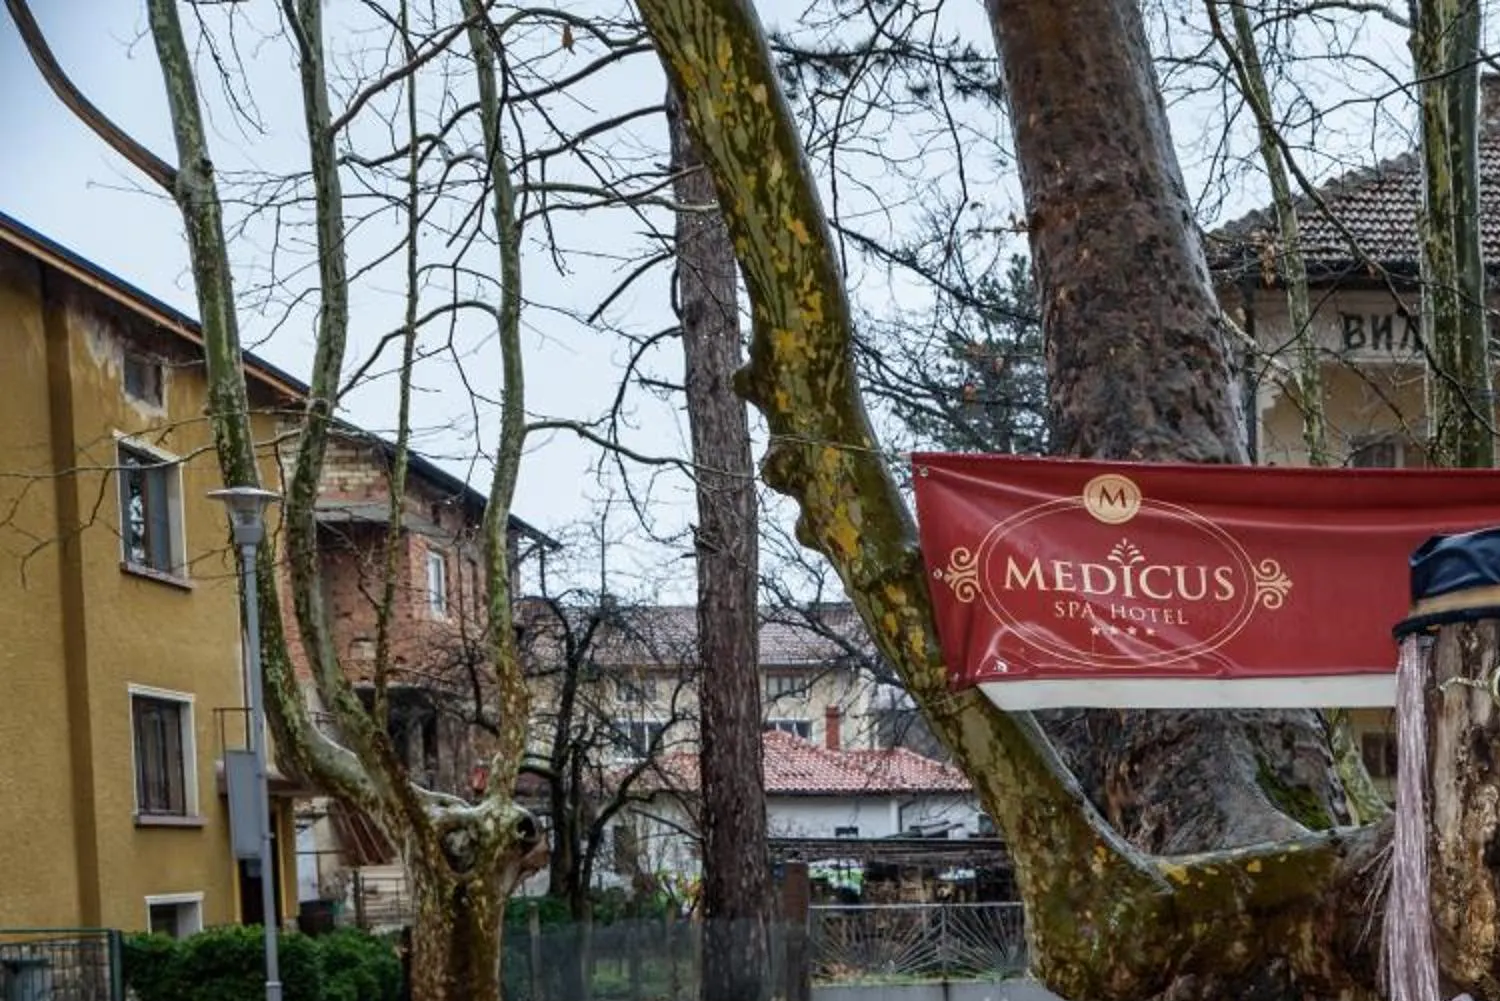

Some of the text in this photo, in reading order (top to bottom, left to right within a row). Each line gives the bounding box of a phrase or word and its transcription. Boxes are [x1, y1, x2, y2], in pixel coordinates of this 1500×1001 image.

[1343, 313, 1425, 351] ВИЛ
[1099, 484, 1127, 509] M
[1003, 555, 1236, 601] MEDICUS
[1054, 601, 1189, 625] SPA HOTEL
